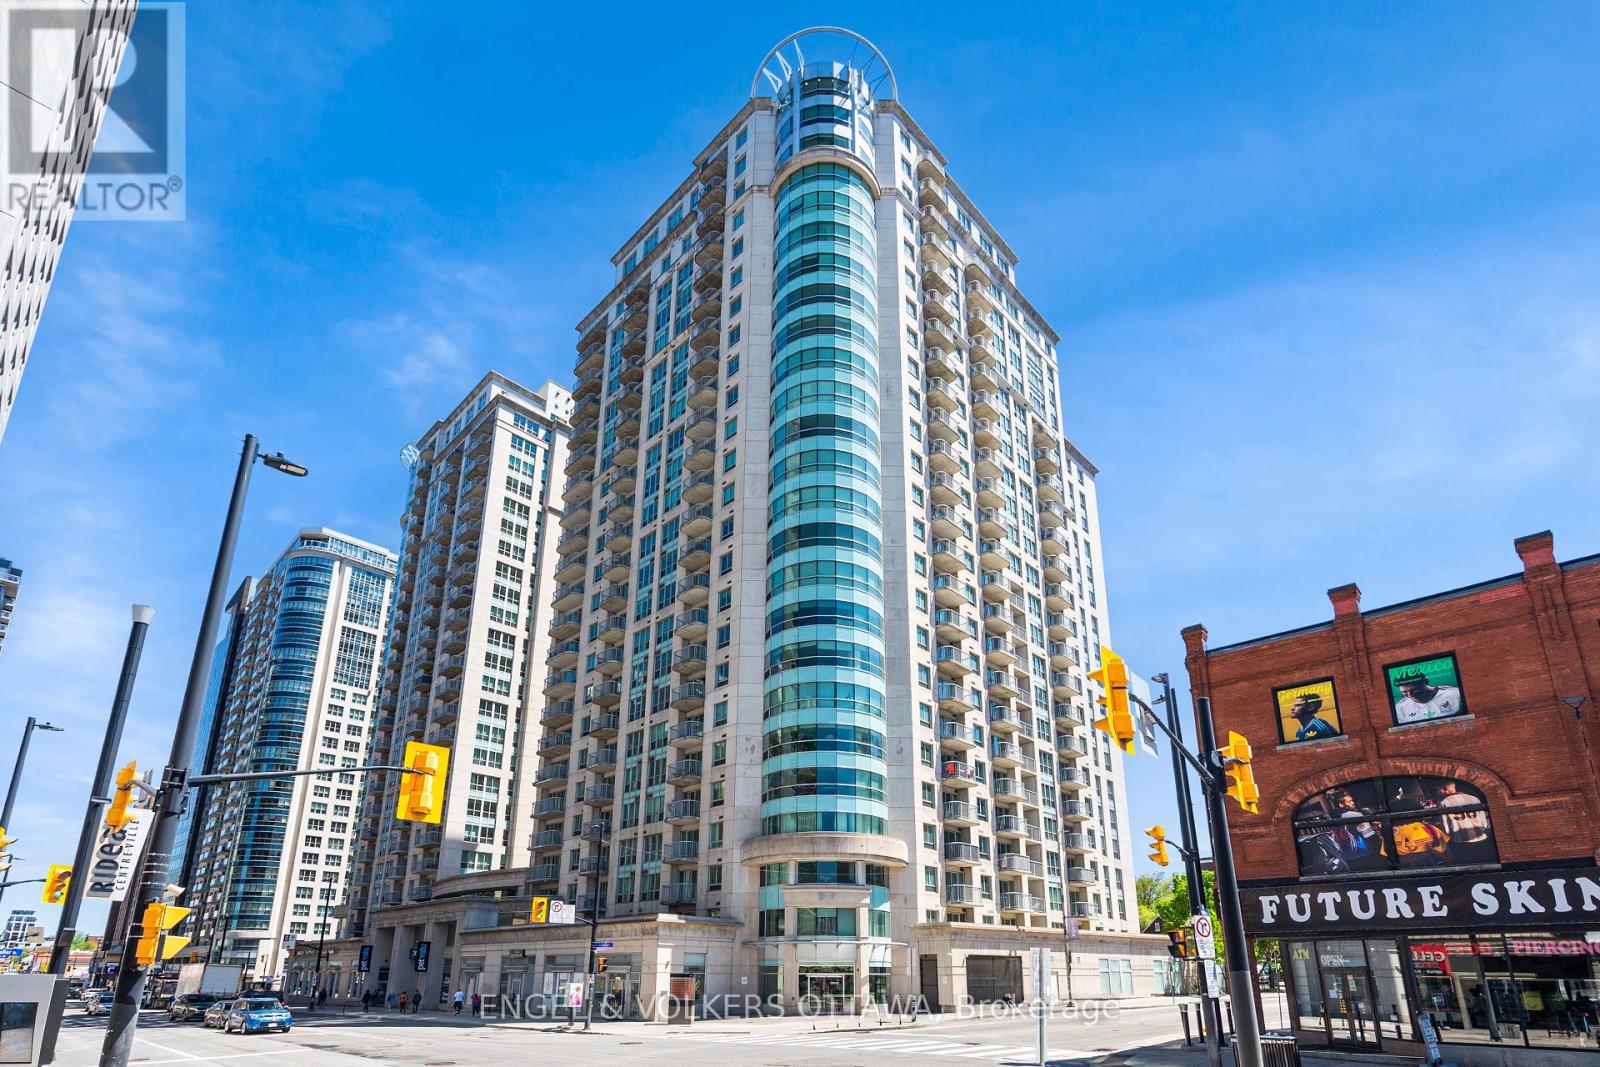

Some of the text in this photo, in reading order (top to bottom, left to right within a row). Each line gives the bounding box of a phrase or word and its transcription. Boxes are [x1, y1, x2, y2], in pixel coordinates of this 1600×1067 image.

[1277, 683, 1332, 702] Germany
[1258, 885, 1449, 924] FUTURE
[1293, 948, 1310, 960] ATM
[1320, 954, 1345, 966] OPEN
